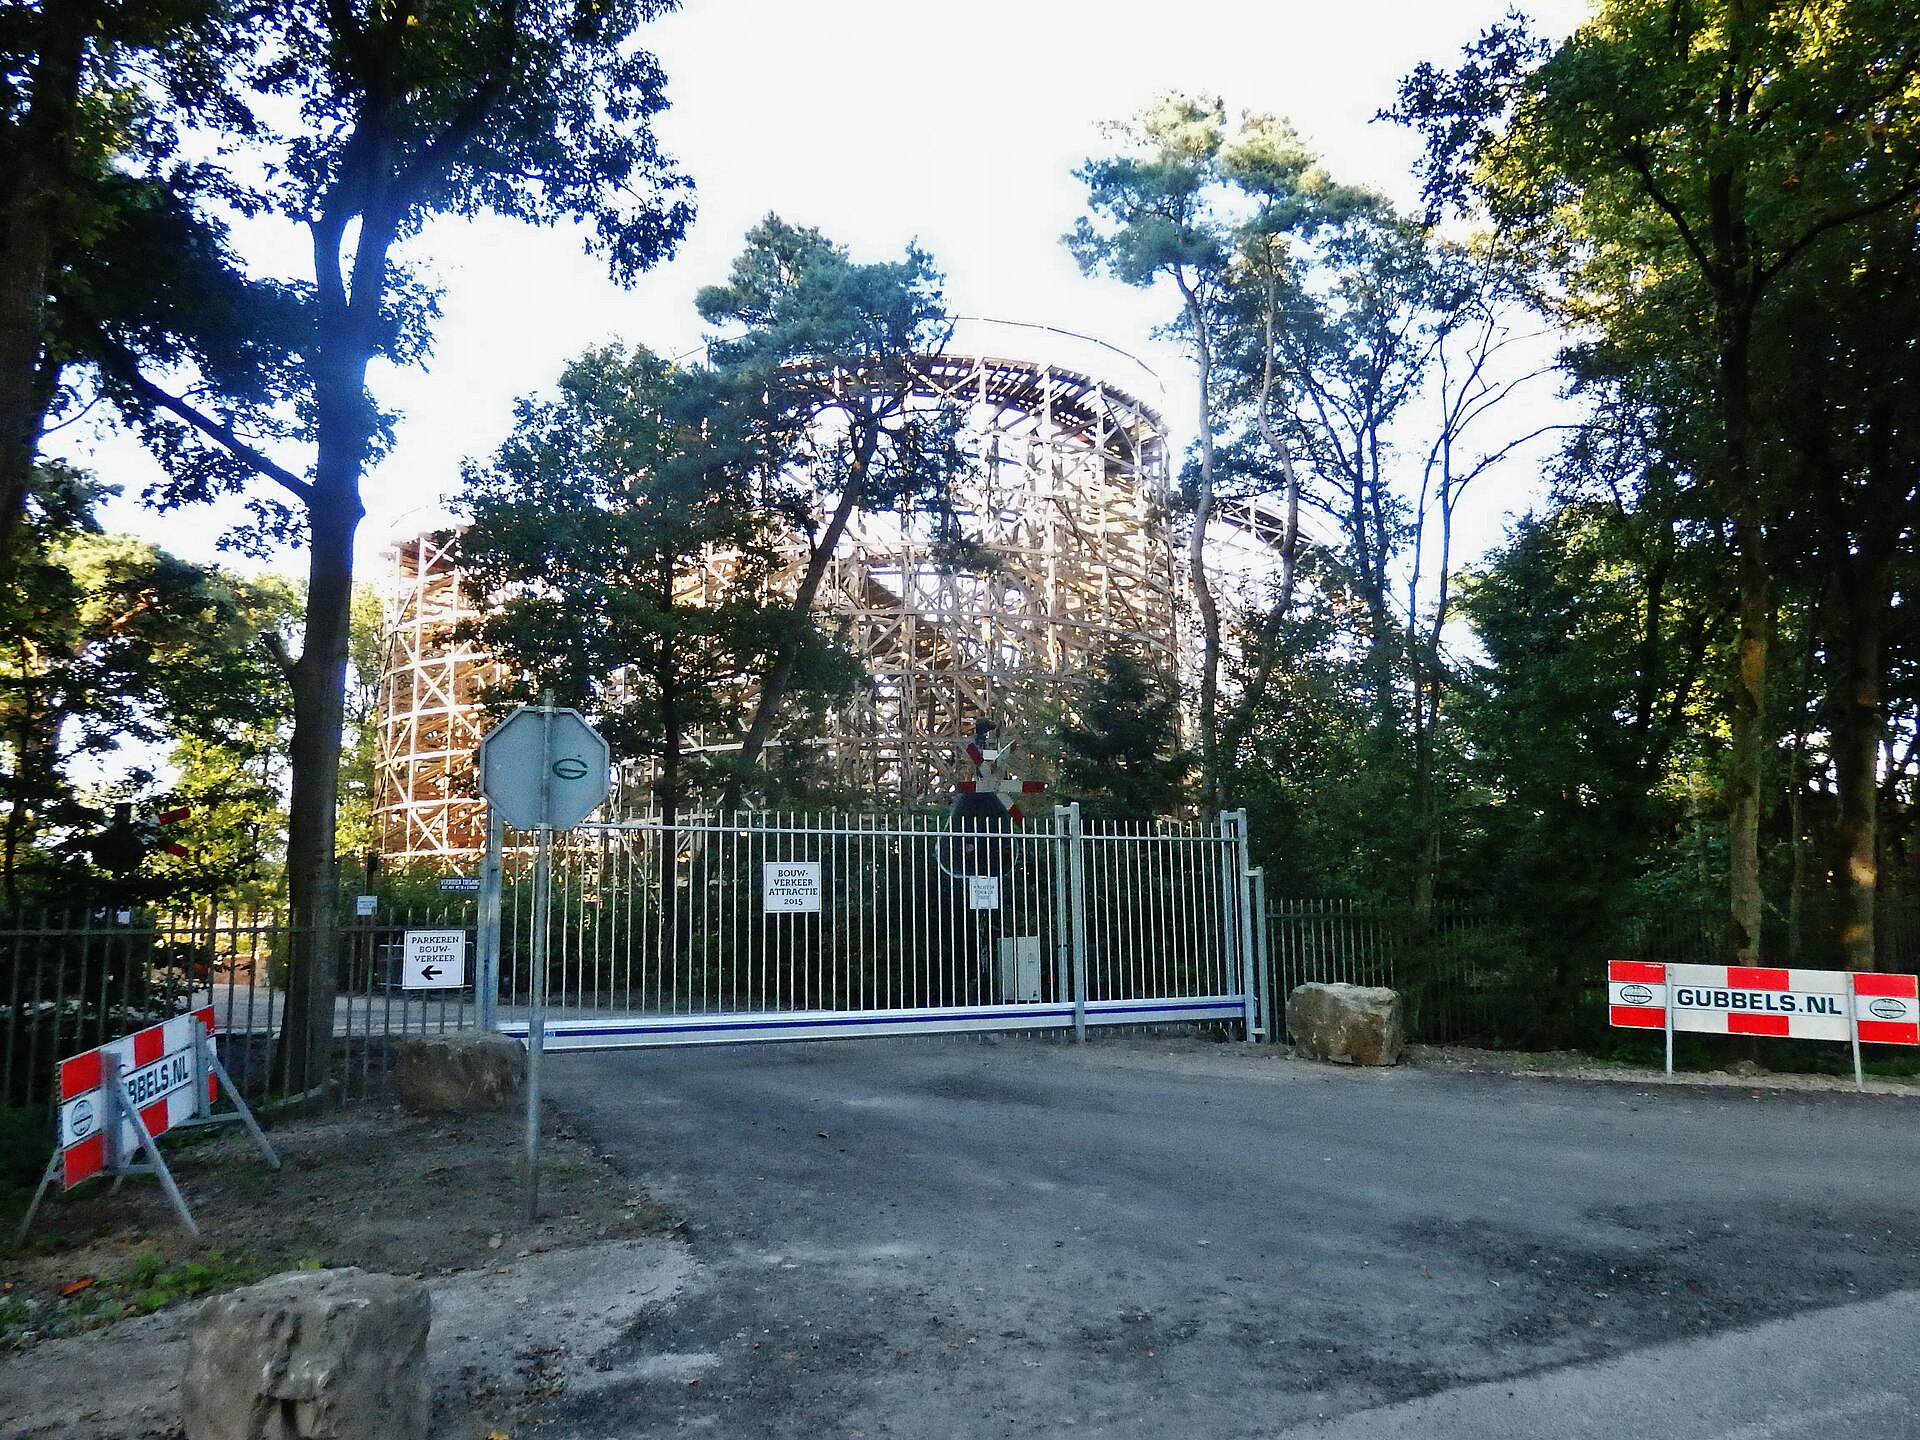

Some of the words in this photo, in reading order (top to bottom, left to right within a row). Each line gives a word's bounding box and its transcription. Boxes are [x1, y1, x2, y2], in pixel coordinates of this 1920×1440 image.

[778, 869, 809, 877] BOUW-
[773, 878, 813, 887] VERKEER
[768, 887, 818, 896] ATTRACTIE
[784, 898, 803, 906] 2015
[411, 936, 459, 944] PARKEREN
[419, 945, 451, 953] BOUW-
[414, 954, 455, 962] VERKEER
[1677, 989, 1842, 1015] GUBBELS.NL
[128, 1056, 189, 1104] BBELS.NL
